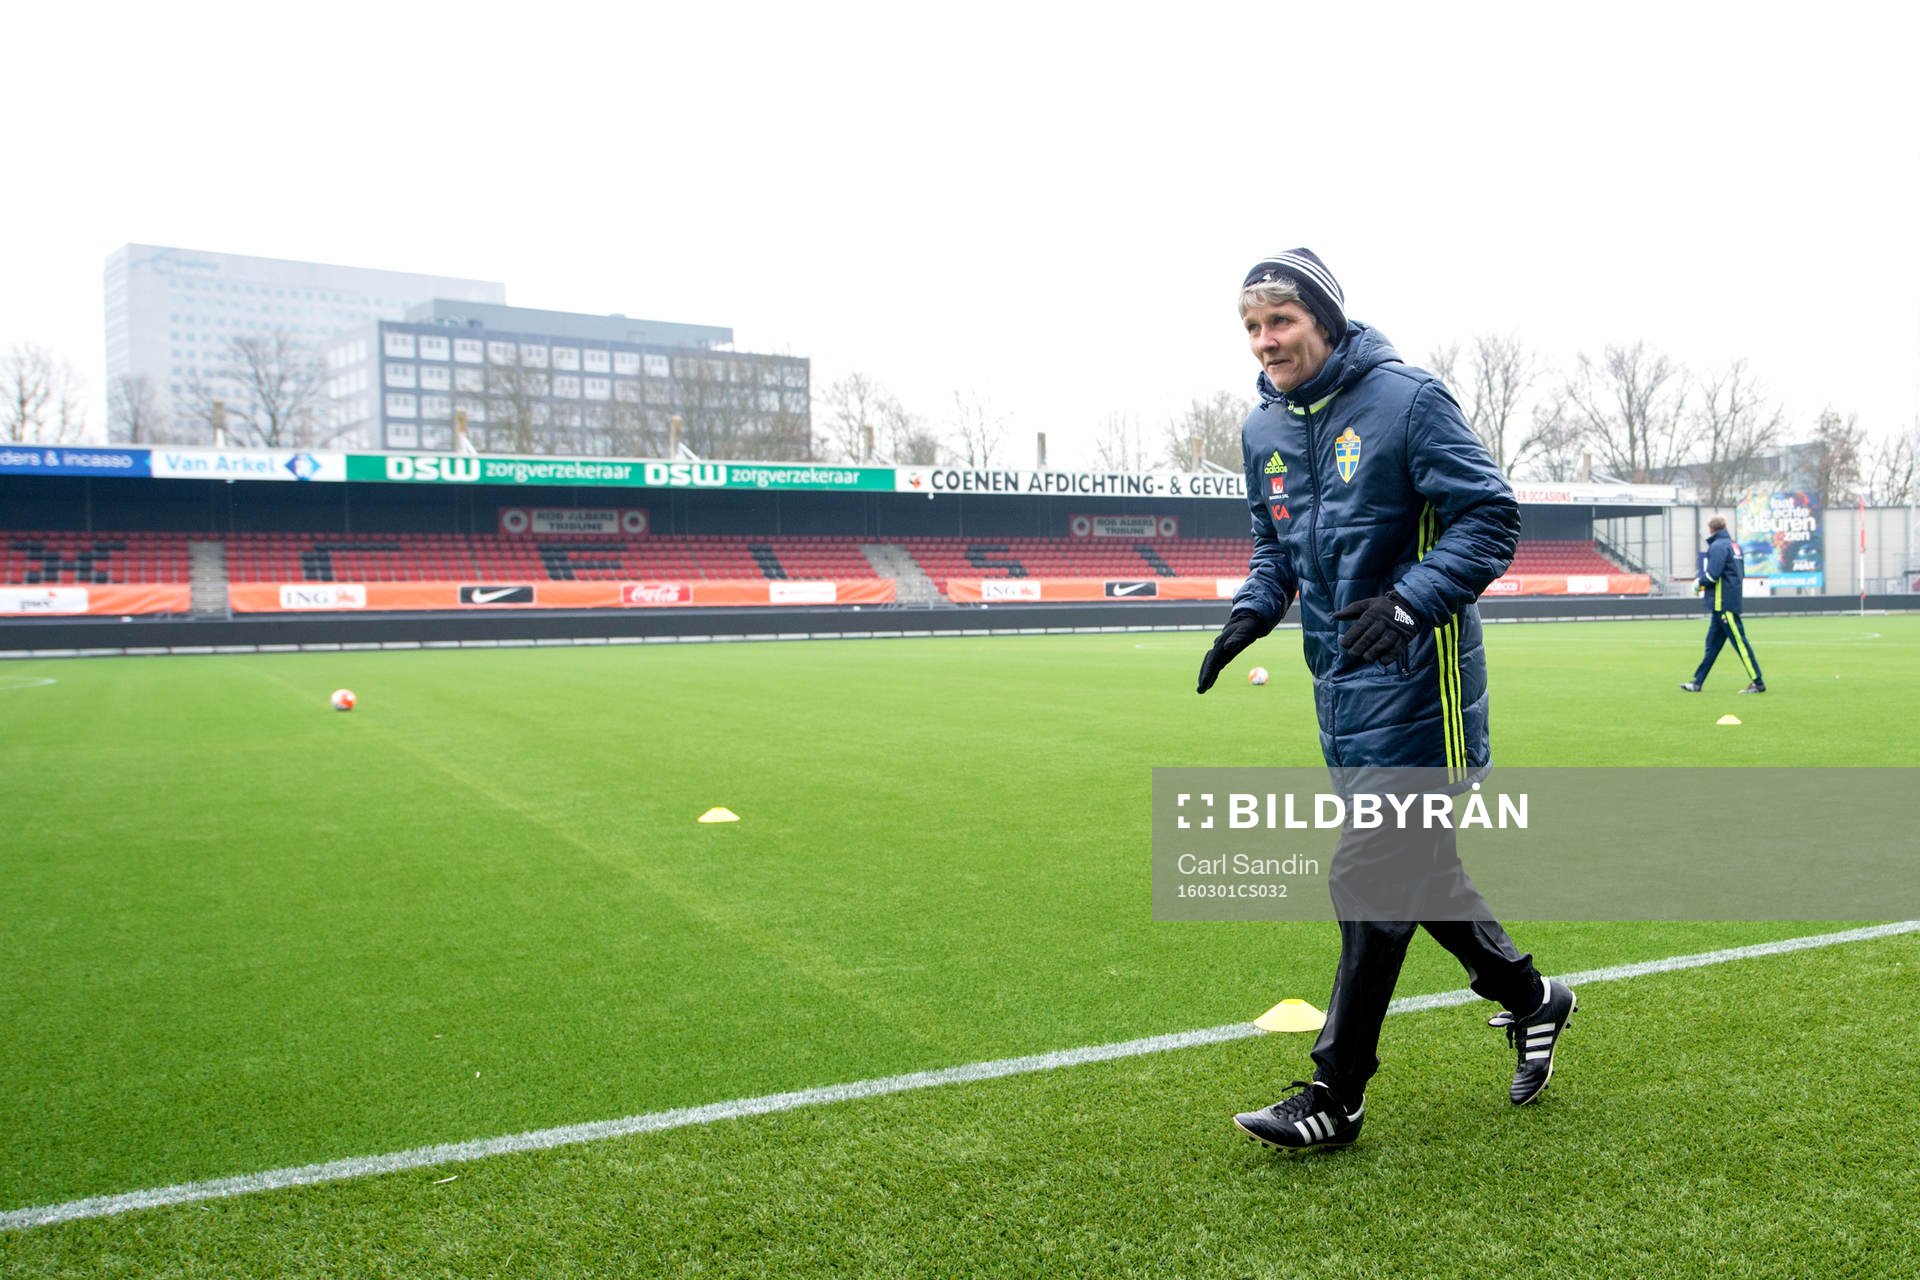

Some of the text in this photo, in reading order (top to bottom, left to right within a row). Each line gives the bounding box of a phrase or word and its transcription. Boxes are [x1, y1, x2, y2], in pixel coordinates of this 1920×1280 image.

[45, 450, 60, 466] &
[64, 452, 133, 468] incasso
[167, 454, 276, 474] Van Arkel
[386, 457, 632, 482] DSW zorgverzekeraar
[645, 464, 860, 487] DSW zorgverzekeraar
[1264, 465, 1287, 474] adidas
[932, 470, 1019, 491] COENEN
[1028, 472, 1163, 495] AFDICHTING-
[1170, 477, 1182, 495] &
[1529, 492, 1571, 503] OCCASIONS
[1272, 504, 1291, 520] ICA
[1743, 514, 1816, 532] kleuren
[1783, 531, 1810, 541] zien
[286, 585, 329, 605] ING
[985, 582, 1017, 599] ING
